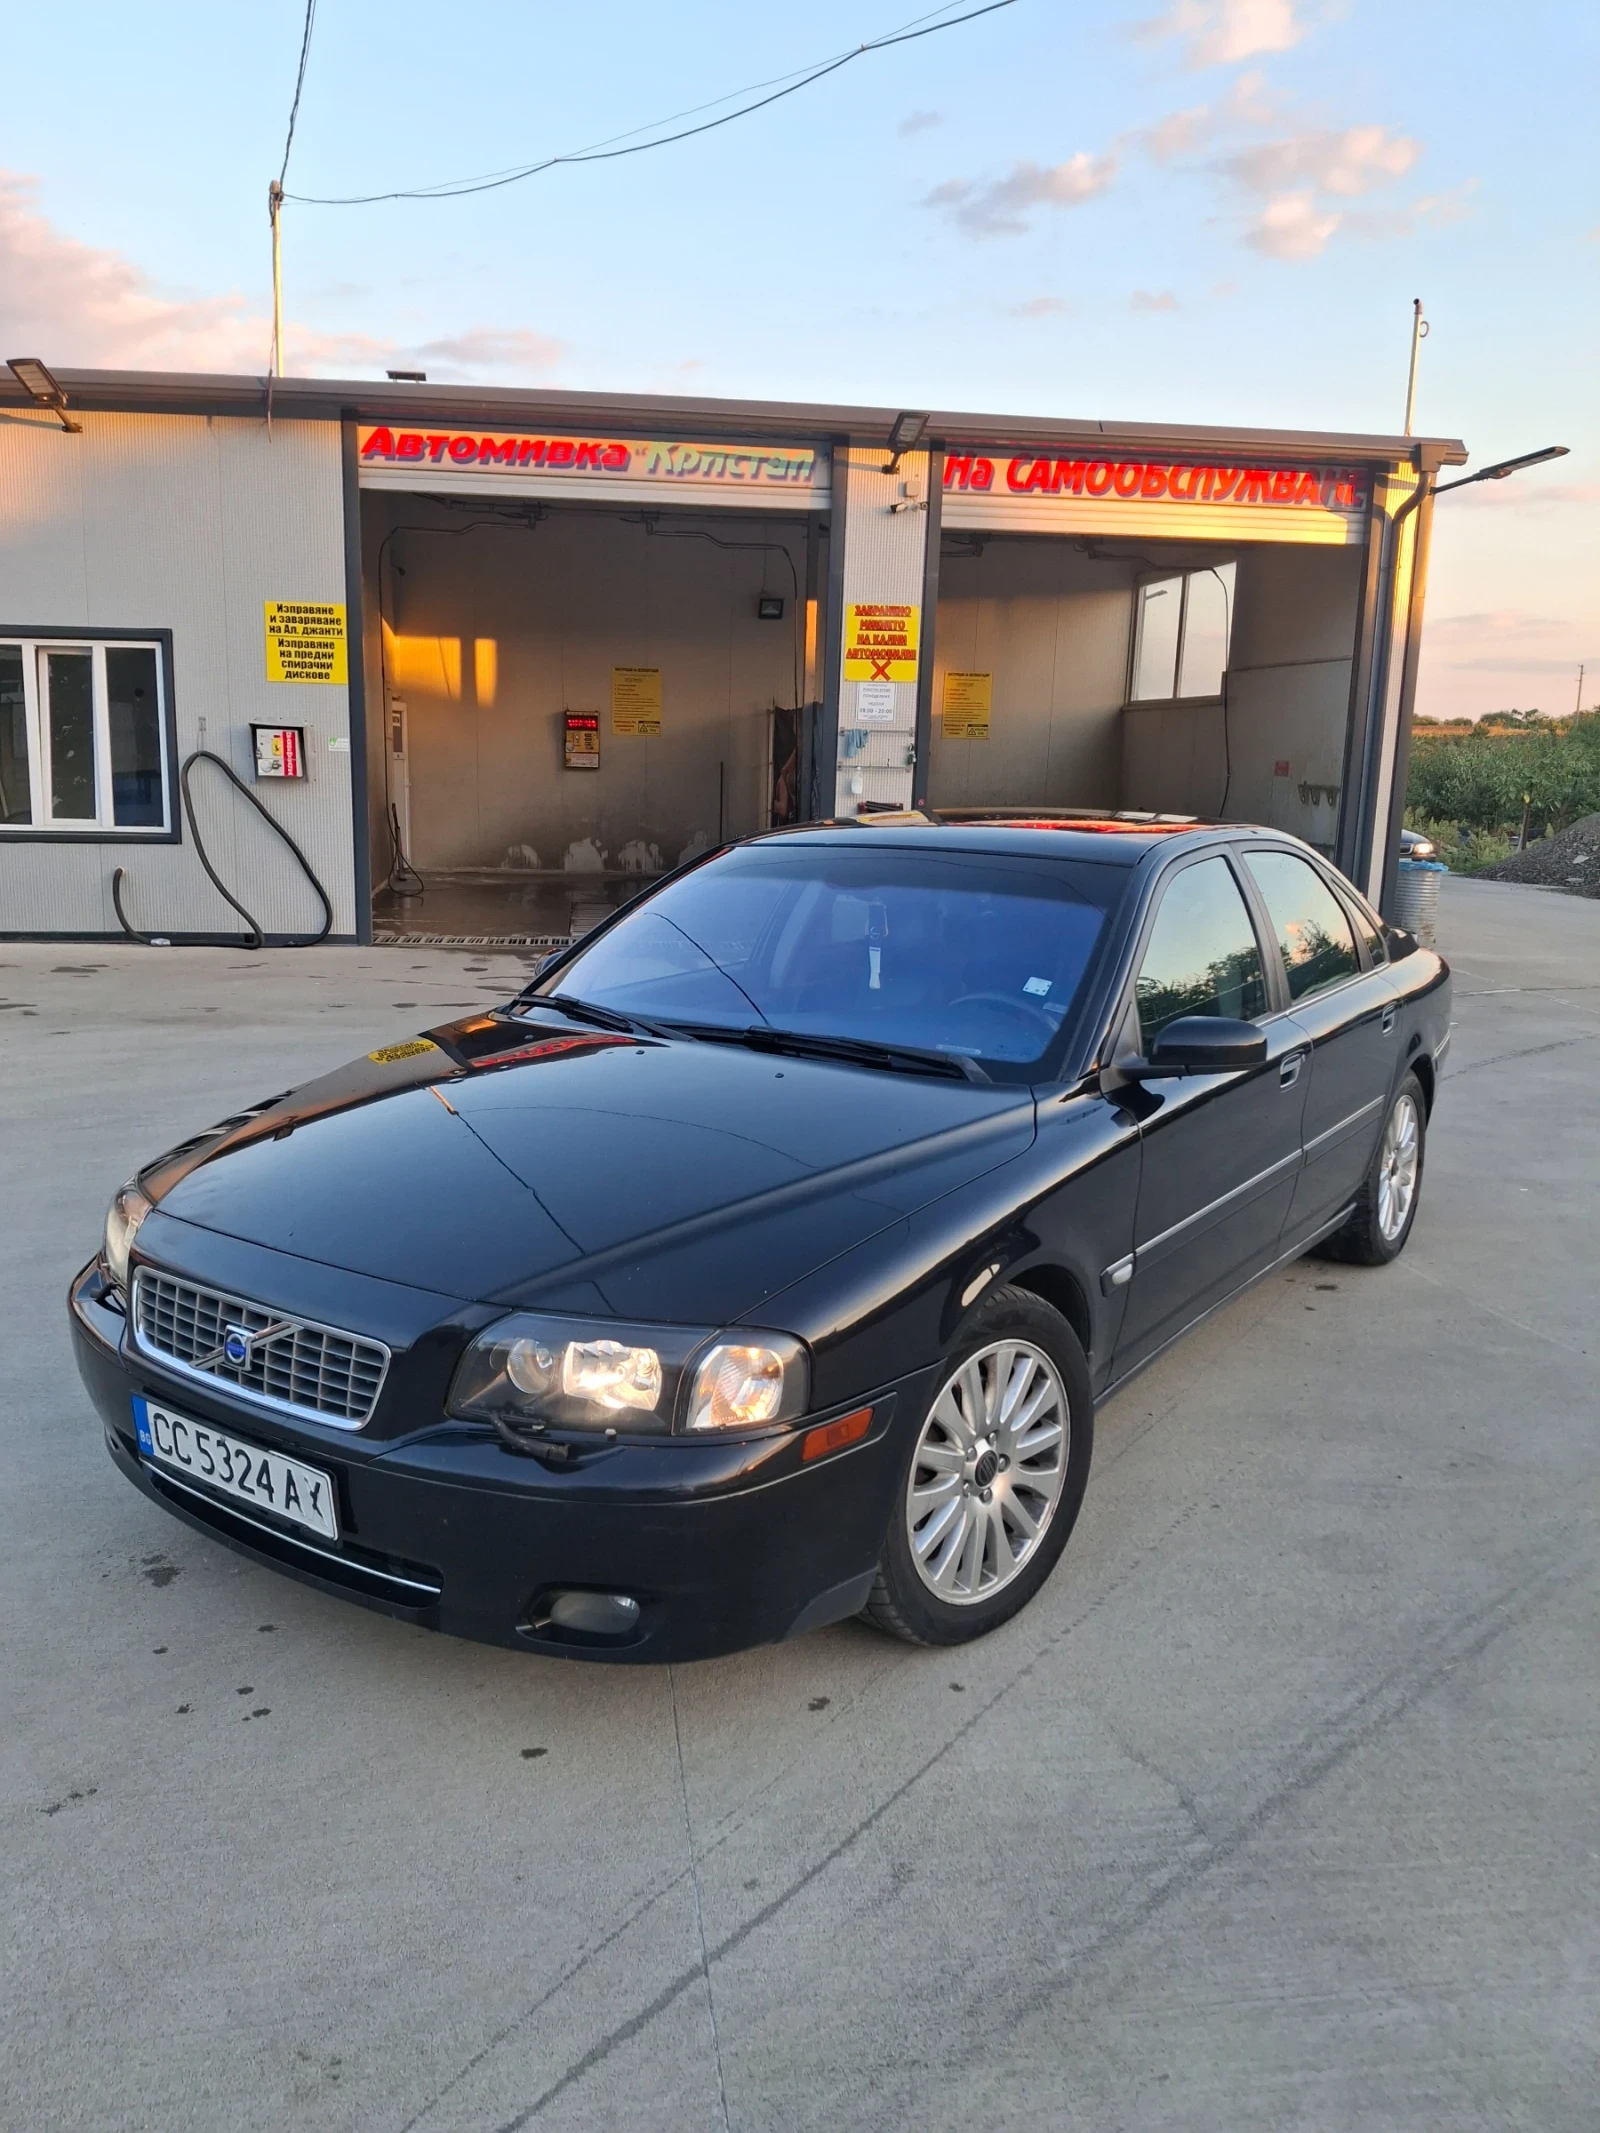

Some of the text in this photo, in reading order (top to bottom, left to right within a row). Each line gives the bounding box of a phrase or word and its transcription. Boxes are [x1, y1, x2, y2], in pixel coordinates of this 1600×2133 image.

[361, 426, 630, 471] Автомивка
[943, 449, 995, 490] На
[277, 604, 335, 616] Изправяне
[279, 616, 342, 626] заваряване
[269, 625, 343, 636] на Ал. джанти
[278, 638, 335, 650] Изправяне
[279, 650, 335, 660] на предни
[281, 660, 333, 670] спирачни
[285, 670, 330, 680] дискове
[139, 1429, 152, 1445] BG
